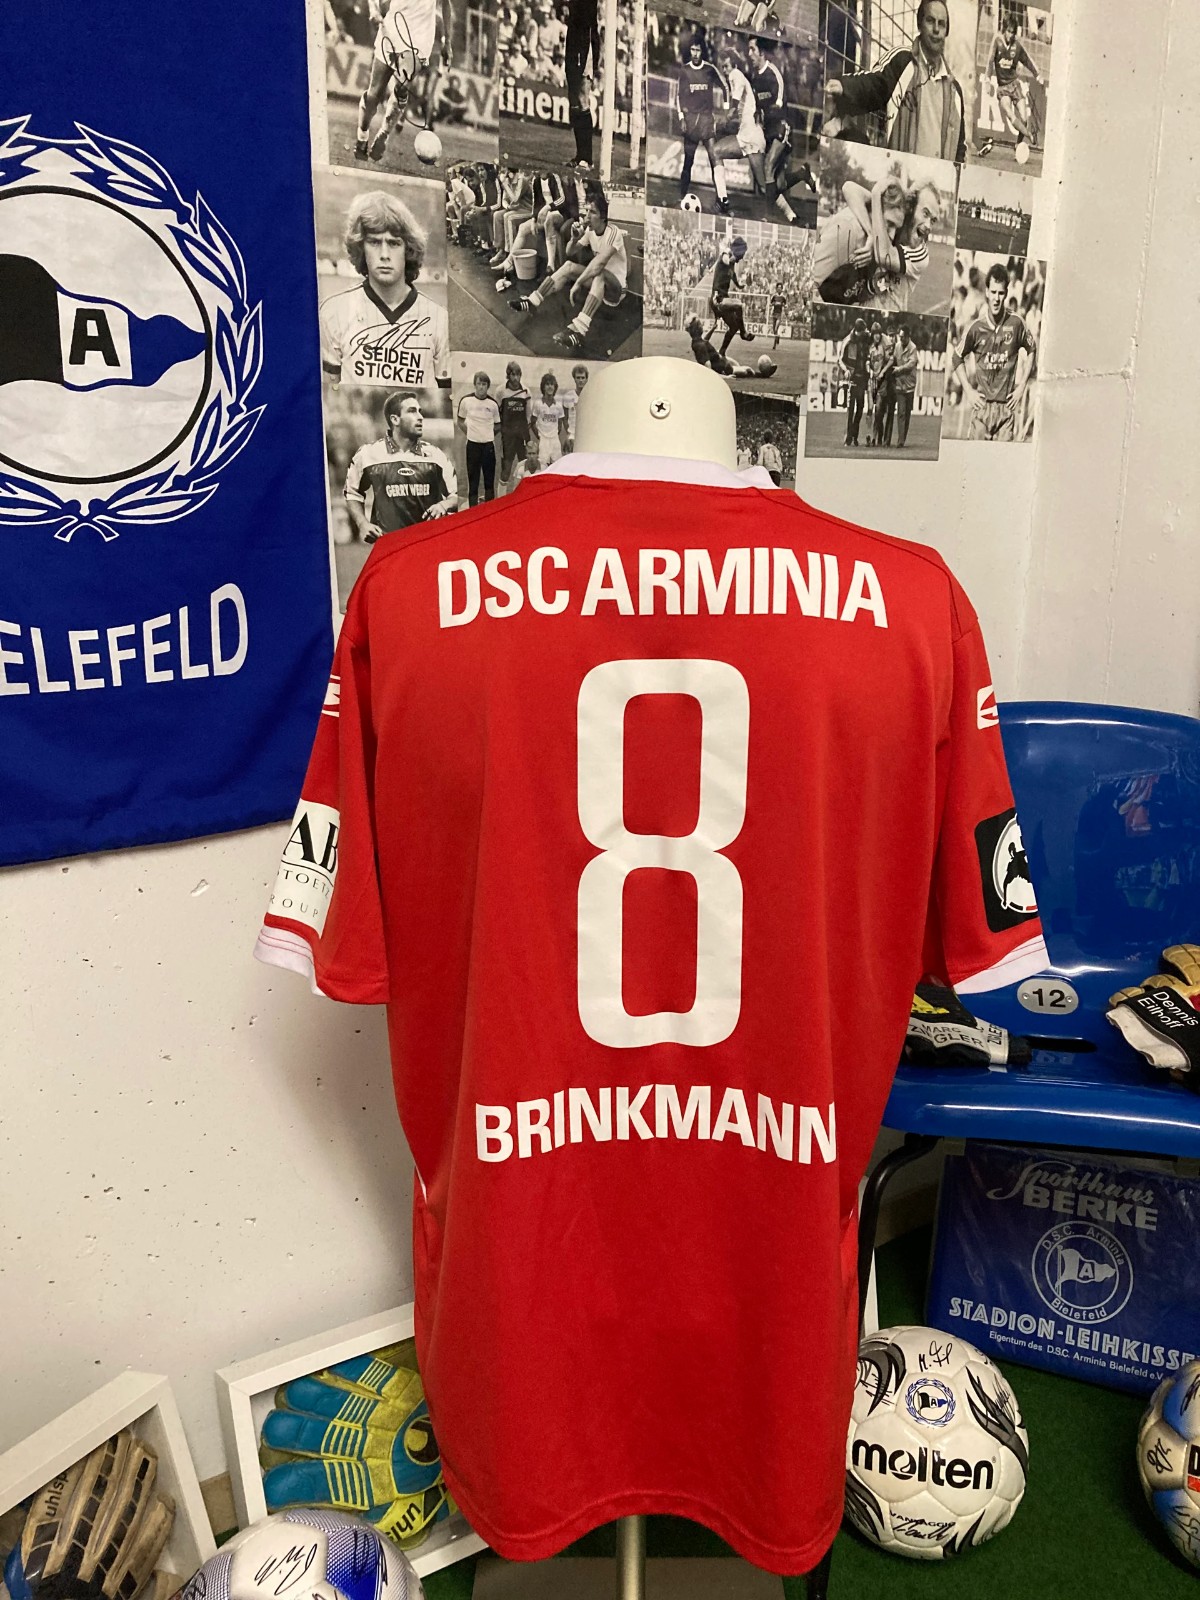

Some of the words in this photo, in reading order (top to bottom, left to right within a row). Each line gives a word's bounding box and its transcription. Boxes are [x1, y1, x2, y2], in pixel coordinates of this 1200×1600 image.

[69, 308, 121, 367] A
[362, 344, 421, 369] SEIDEN
[354, 360, 425, 384] STICKER
[437, 546, 570, 629] DSC
[580, 547, 889, 629] ARMINIA
[0, 583, 249, 696] ELEFELD
[577, 659, 750, 1049] 8
[1032, 988, 1066, 1008] 12
[1137, 997, 1185, 1029] Eilhoff
[1152, 991, 1199, 1026] Dennis
[475, 1083, 837, 1165] BRINKMANN
[986, 1160, 1155, 1205] Sporthaus
[1022, 1184, 1159, 1231] BERKE
[1041, 1225, 1075, 1251] D.S.C.
[1086, 1226, 1125, 1266] Arminia
[1051, 1298, 1107, 1320] Bielefeld
[989, 1330, 1027, 1347] Eigentum
[1027, 1340, 1043, 1352] des
[1072, 1351, 1107, 1368] Arminia
[1109, 1361, 1148, 1378] Bielefeld
[852, 1439, 994, 1490] molten
